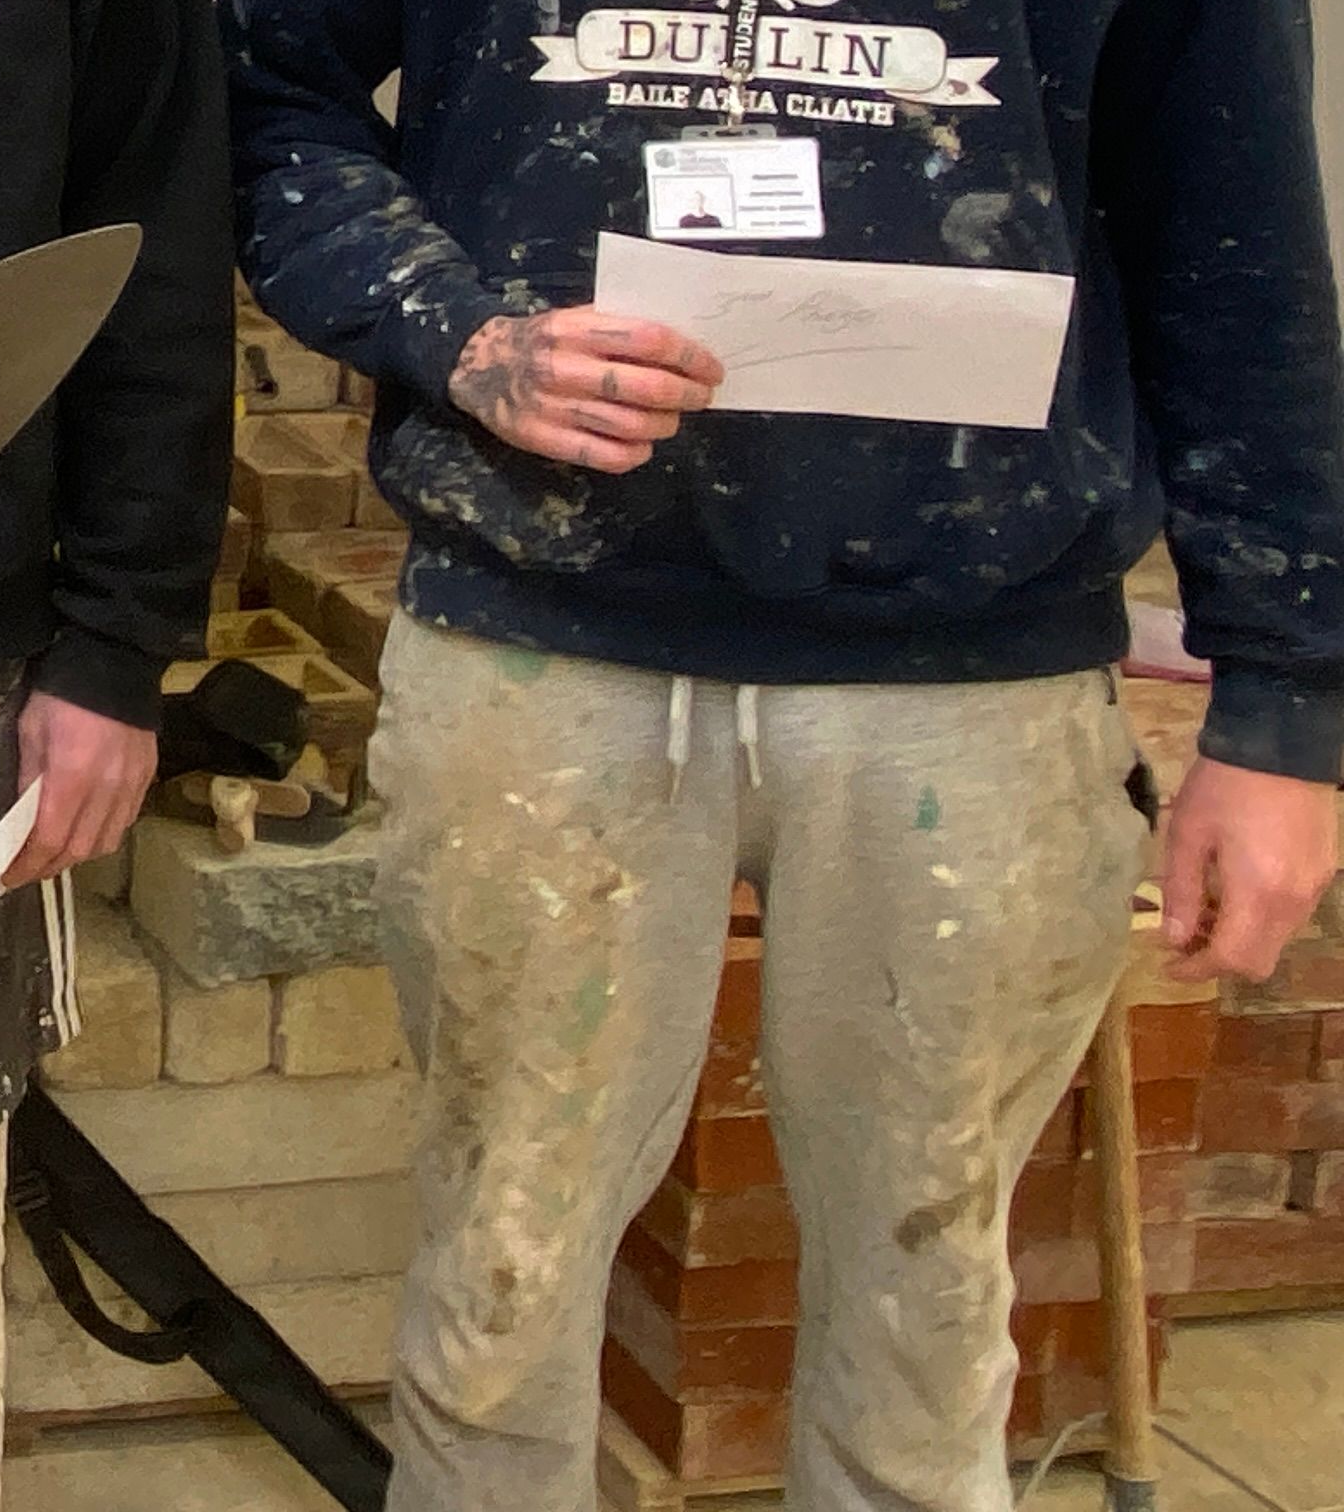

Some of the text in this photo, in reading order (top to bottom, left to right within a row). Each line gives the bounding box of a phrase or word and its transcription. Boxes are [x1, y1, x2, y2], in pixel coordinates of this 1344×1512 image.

[617, 19, 893, 79] DULIN
[606, 82, 690, 110] BAILE
[786, 92, 896, 126] CLIATH
